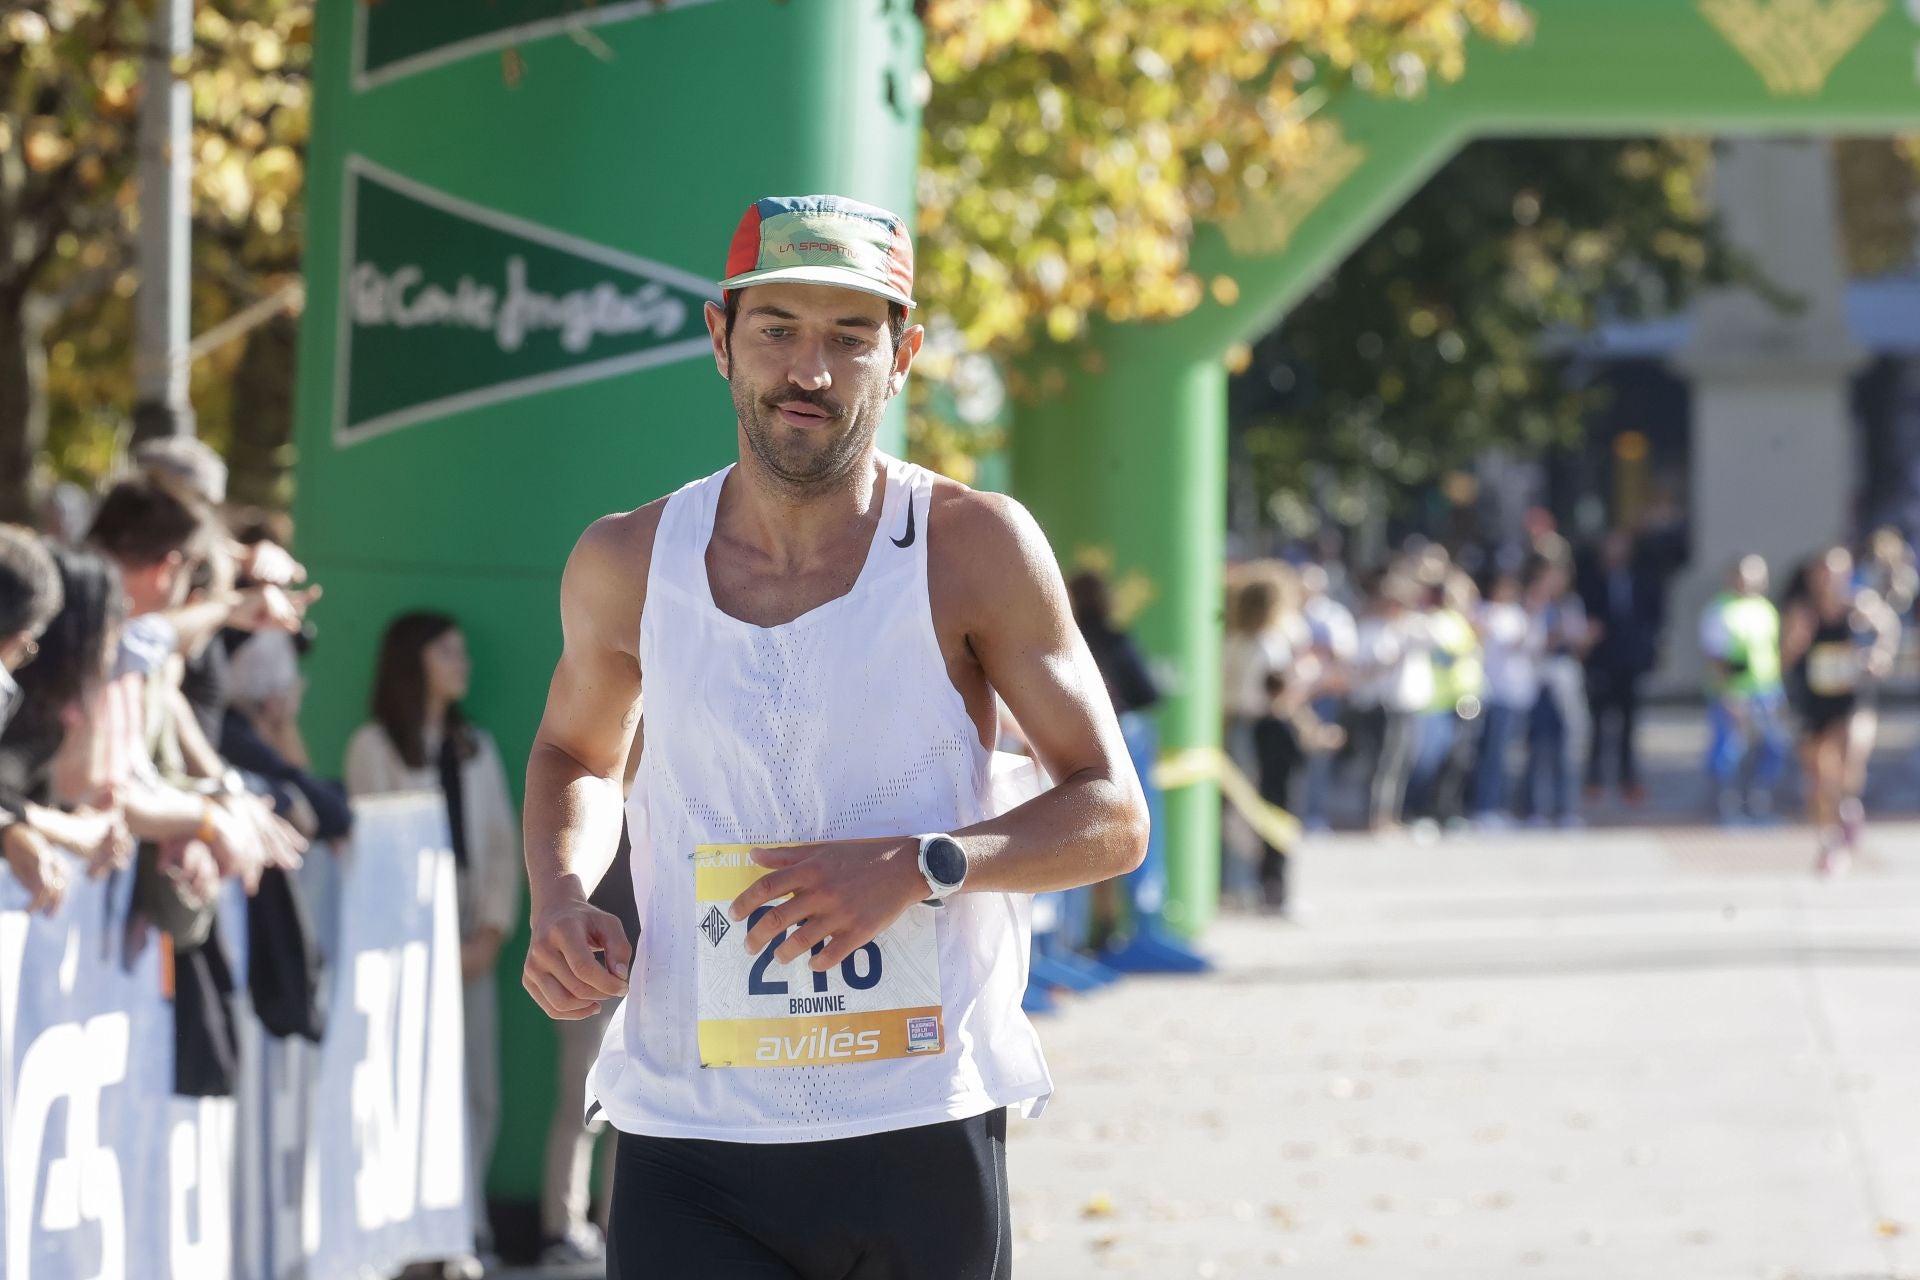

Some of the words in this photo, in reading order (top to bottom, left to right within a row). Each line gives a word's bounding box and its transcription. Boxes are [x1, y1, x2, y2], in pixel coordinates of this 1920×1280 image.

[779, 243, 795, 253] LA
[799, 242, 860, 259] SPORTIV
[789, 994, 846, 1015] BROWNIE
[755, 1026, 881, 1061] avilés
